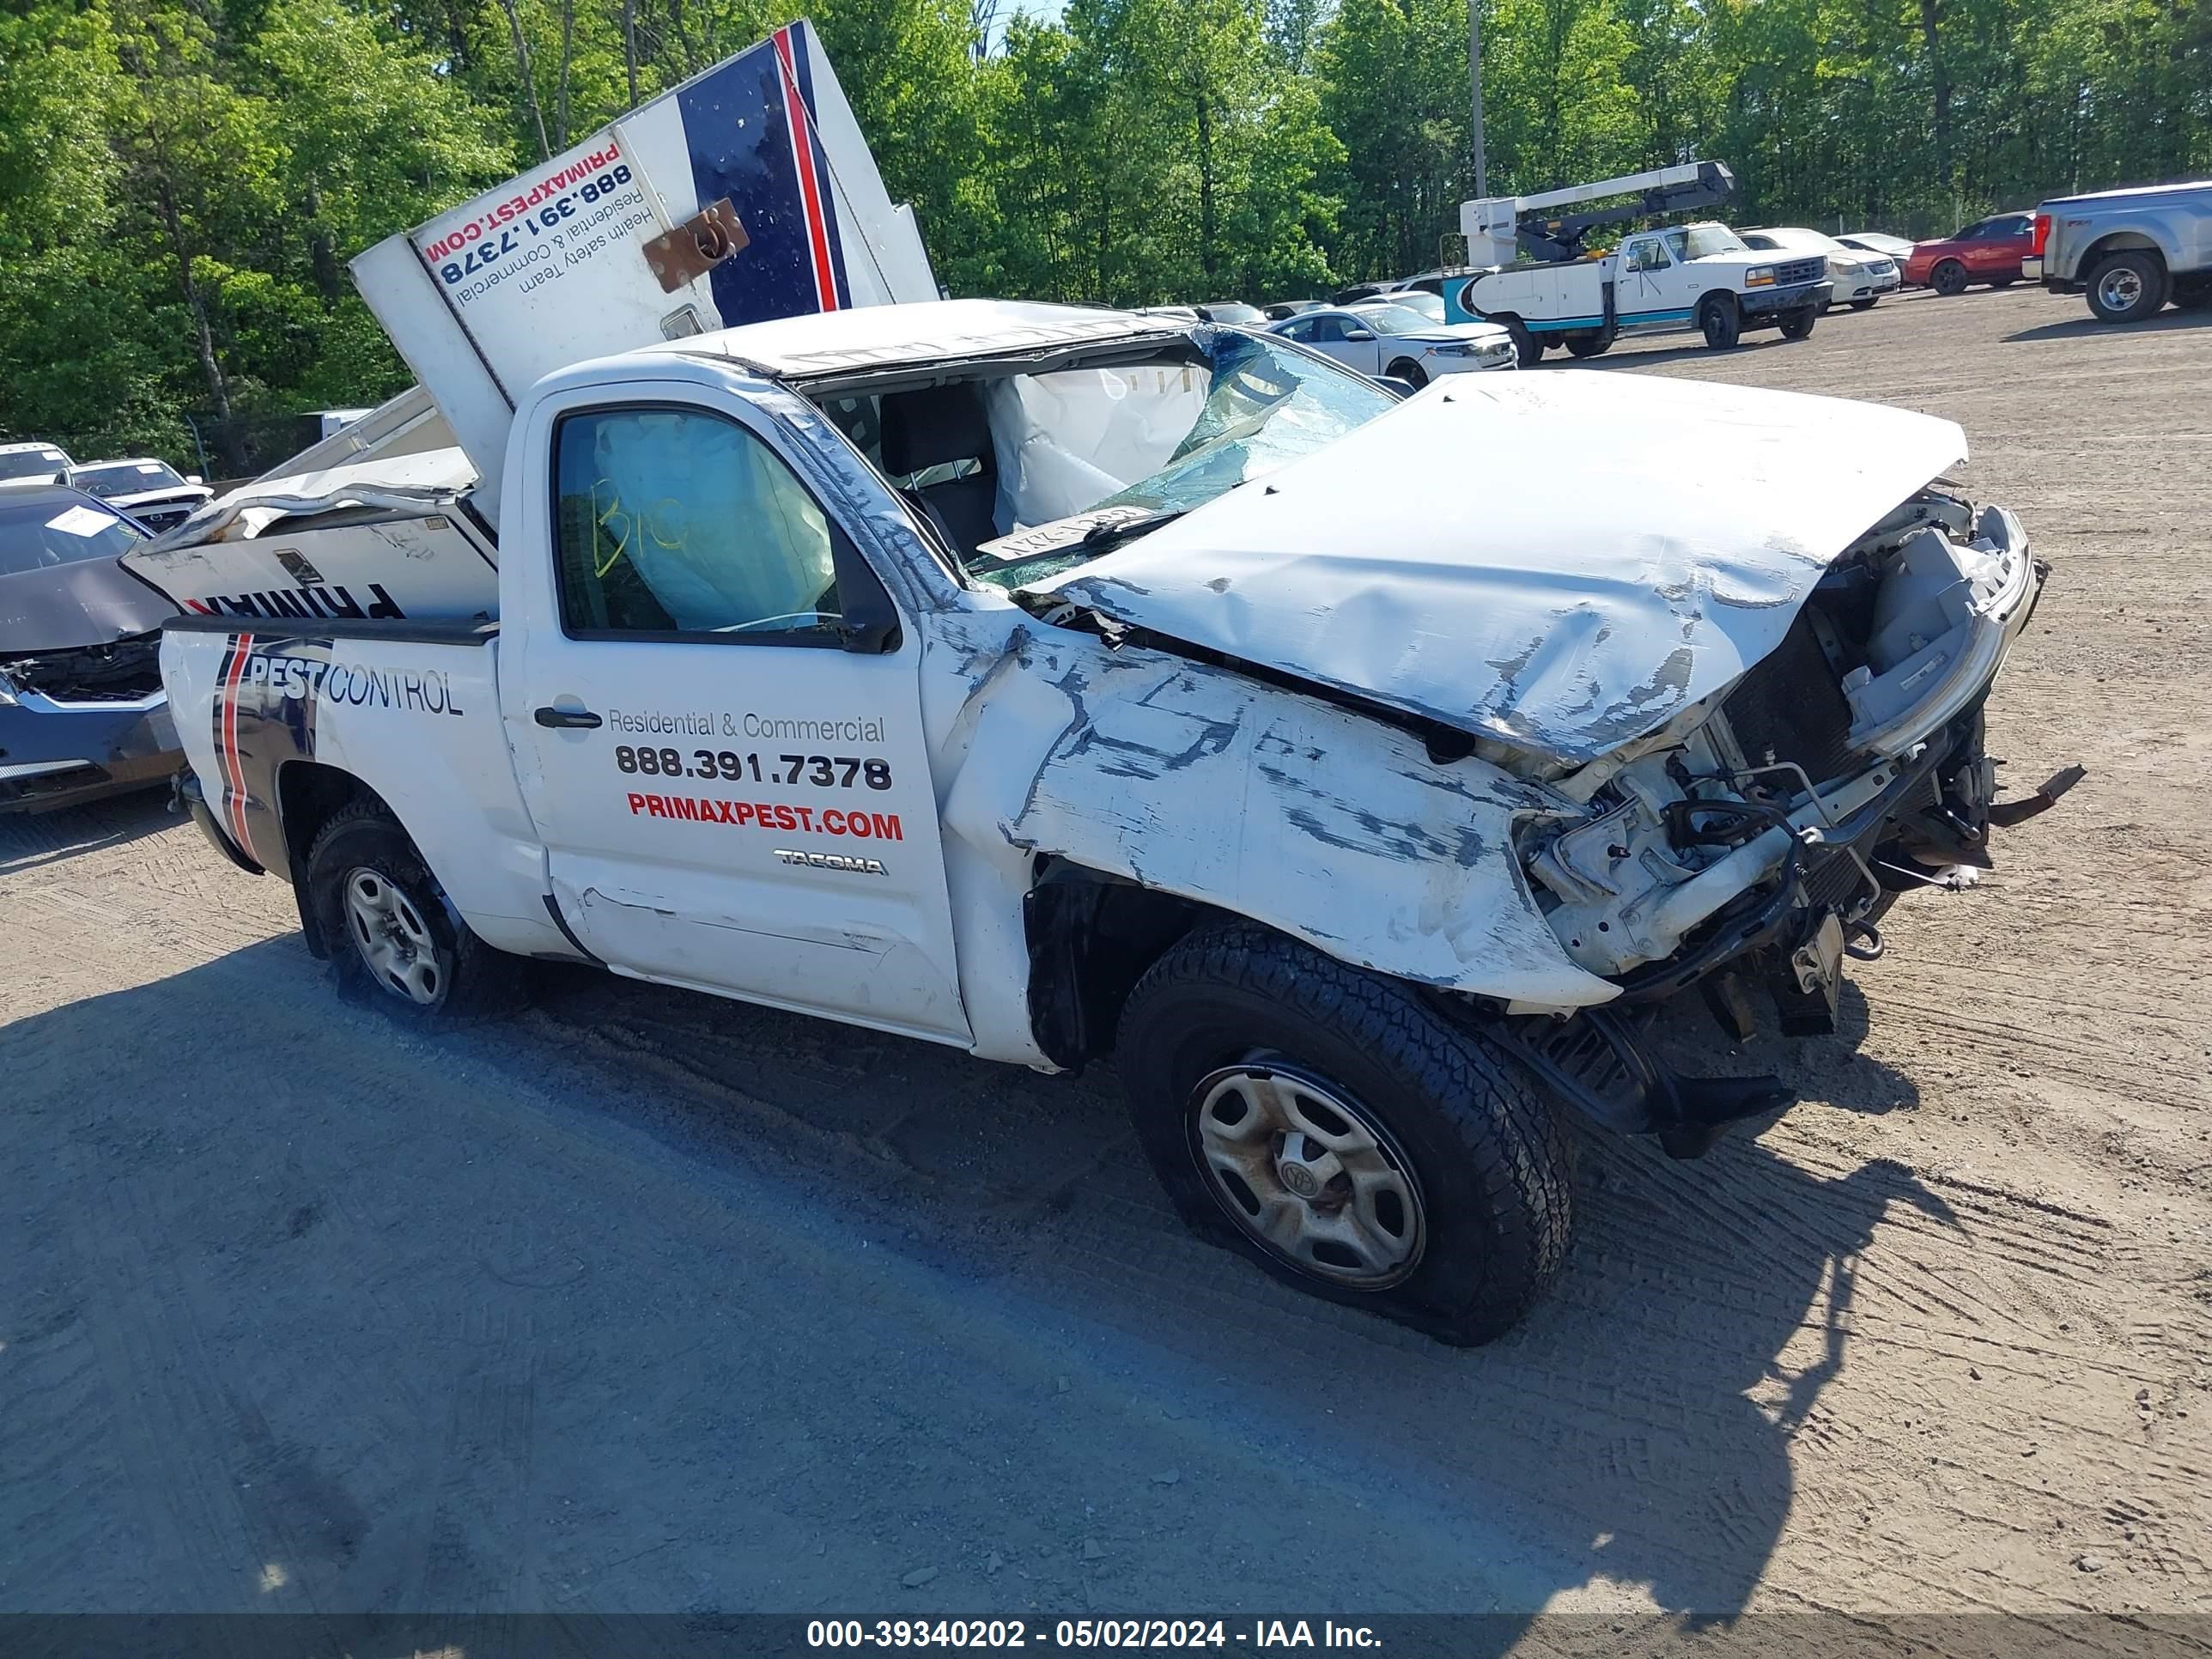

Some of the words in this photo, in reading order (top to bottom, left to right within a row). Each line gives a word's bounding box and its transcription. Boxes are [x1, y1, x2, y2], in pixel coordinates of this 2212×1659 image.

[425, 143, 620, 263] PRIMAXPEST.COM
[441, 164, 633, 285] 888.391.7378
[568, 187, 645, 243] Residential
[609, 207, 655, 241] Health
[550, 234, 566, 246] &
[564, 234, 607, 269] safety
[456, 244, 552, 307] Commercial
[519, 264, 565, 295] Team
[250, 656, 325, 701] PEST
[329, 663, 464, 716] CONTROL
[609, 709, 715, 736] Residential
[722, 713, 738, 738] &
[744, 713, 885, 743] Commercial
[615, 745, 893, 791] 888.391.7378
[626, 792, 904, 842] PRIMAXPEST.COM
[773, 848, 890, 877] TACOMA
